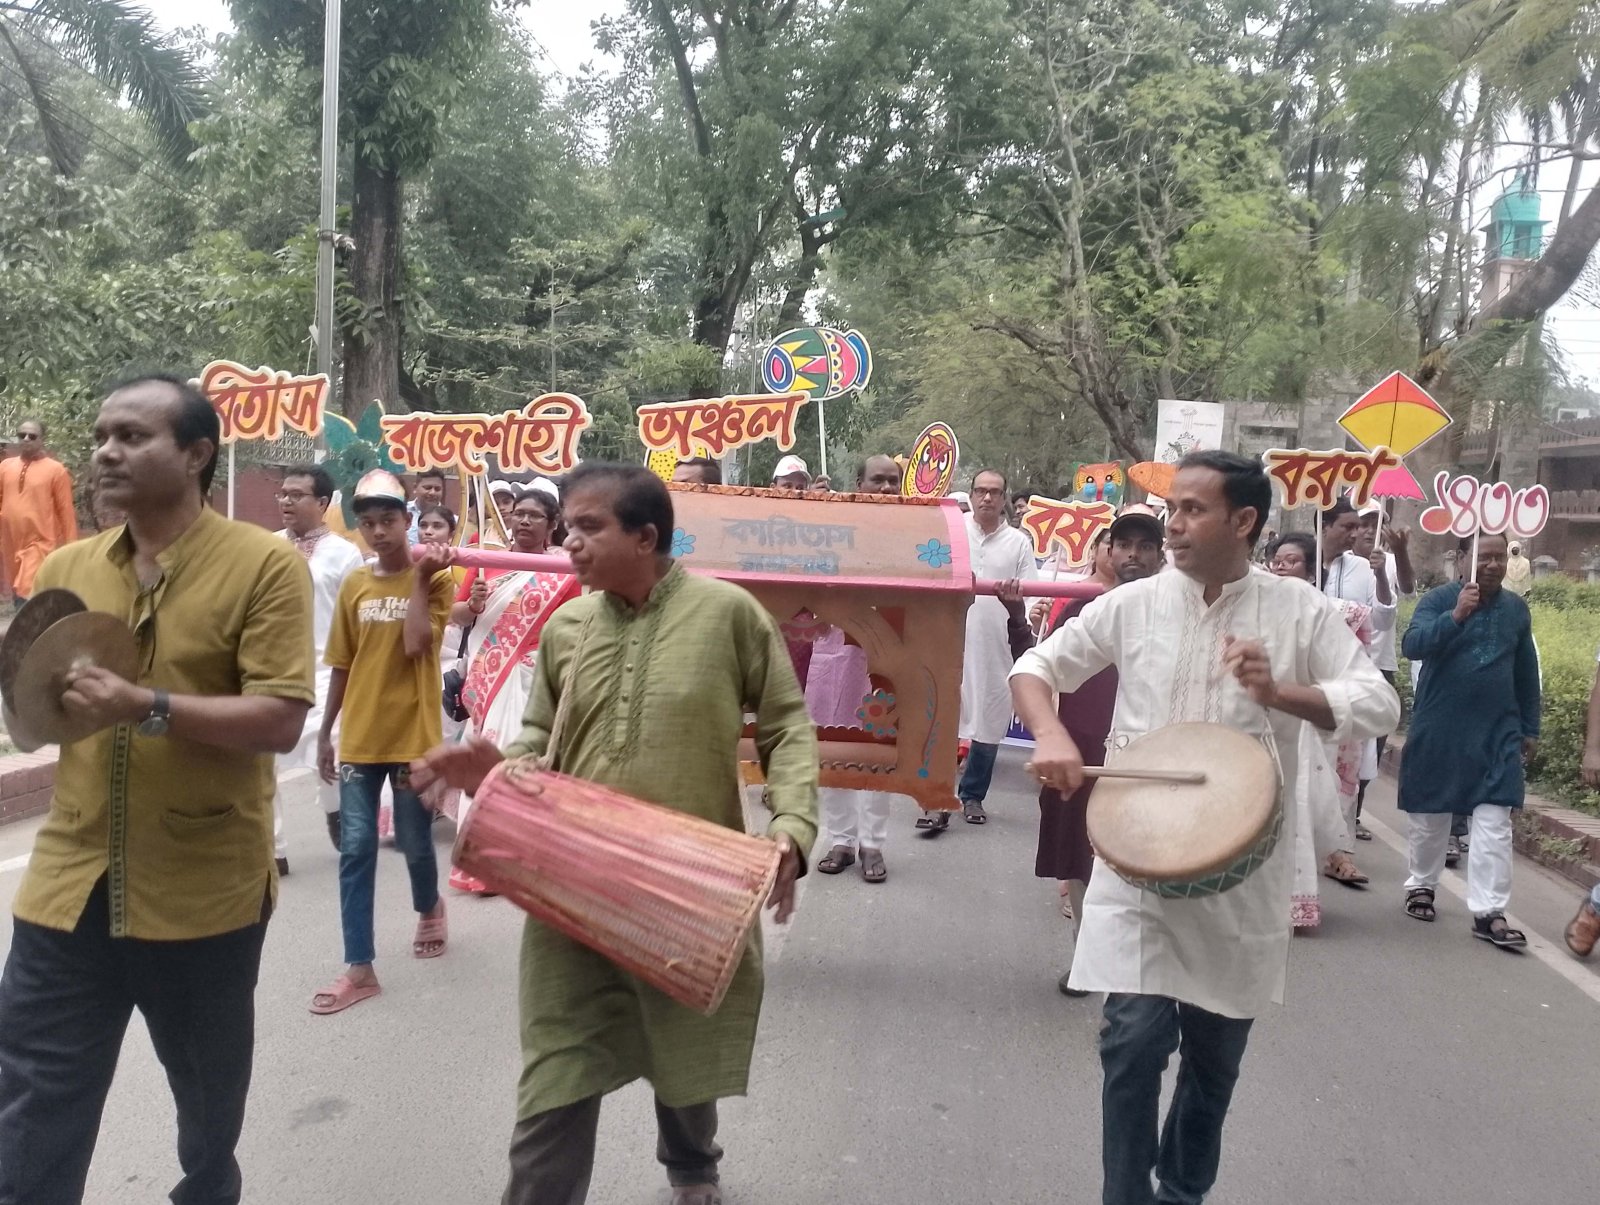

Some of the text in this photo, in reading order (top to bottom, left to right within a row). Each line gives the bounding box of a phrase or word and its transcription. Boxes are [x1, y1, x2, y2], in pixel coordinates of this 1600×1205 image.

[201, 363, 327, 438] রিতাস
[638, 394, 805, 457] অঞ্চল
[382, 395, 586, 474] রাজশাহী
[1268, 449, 1398, 507] বরণ
[1025, 499, 1113, 563] বর্ষ
